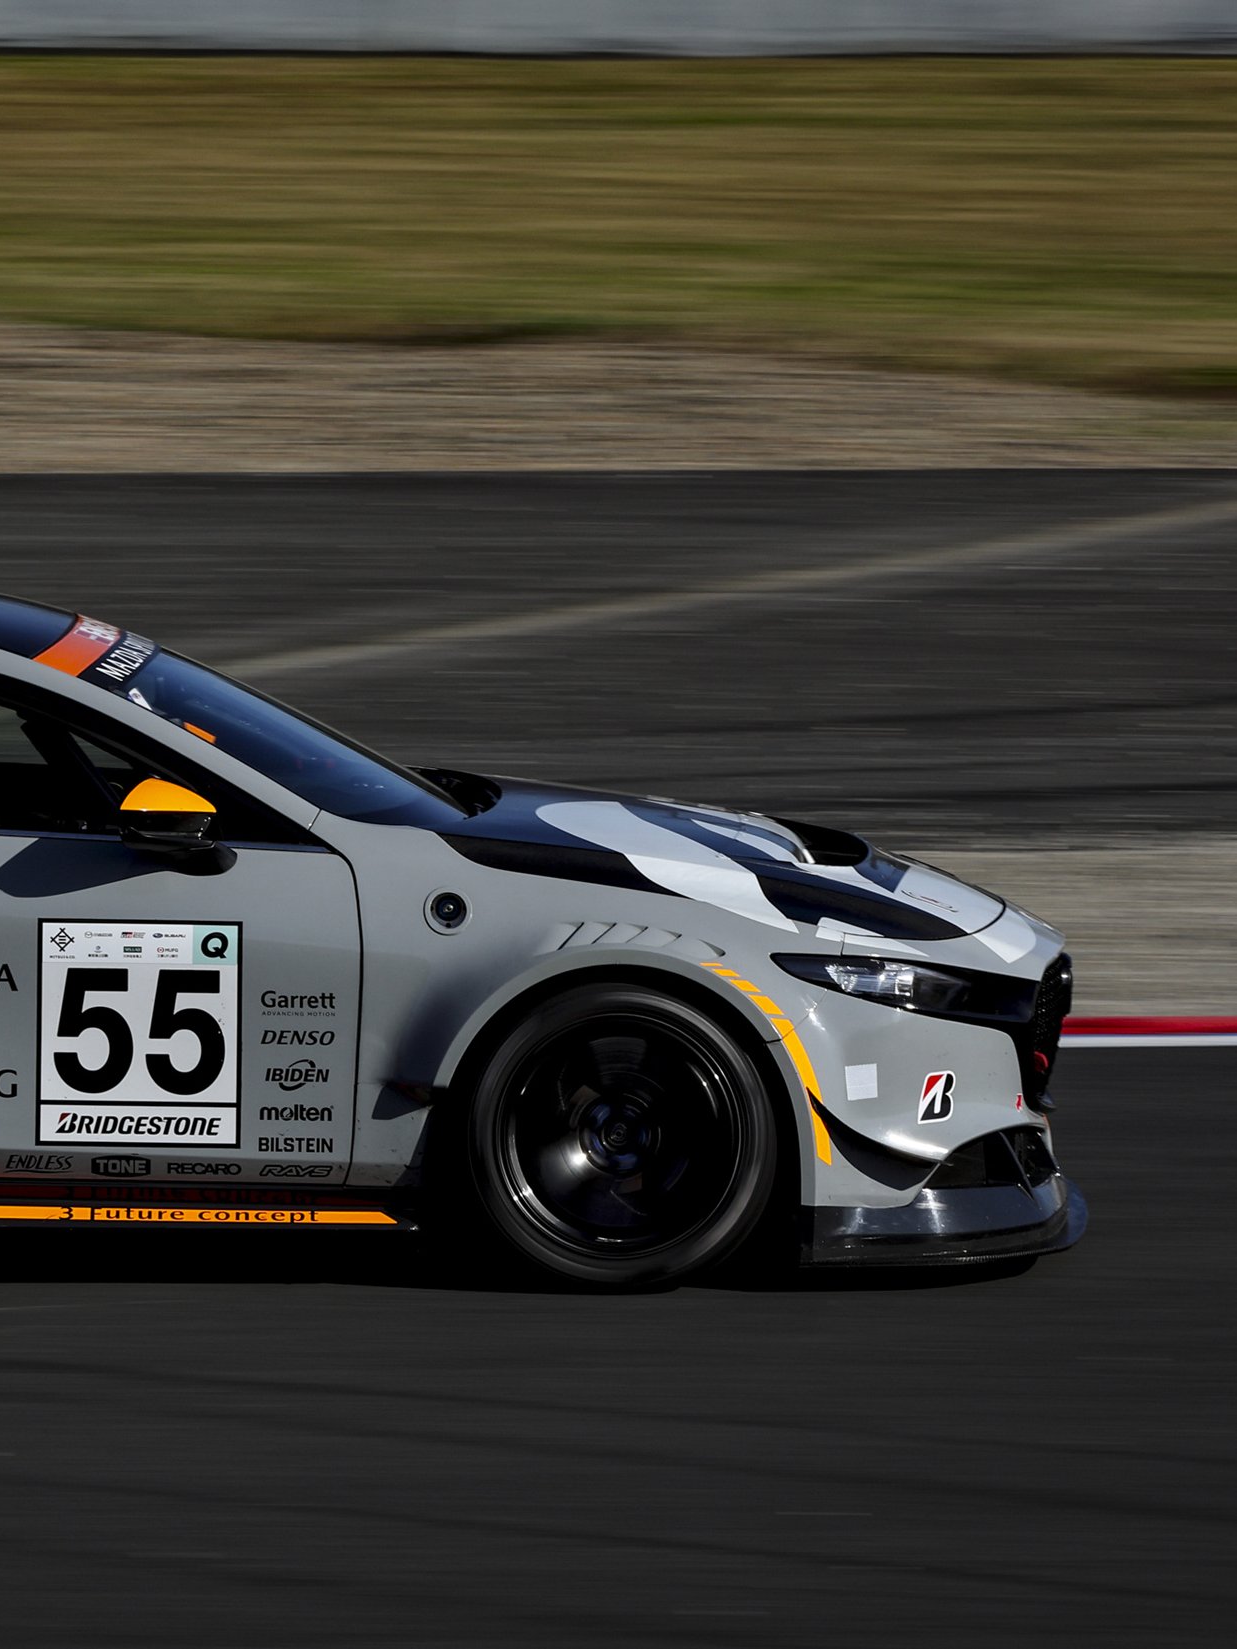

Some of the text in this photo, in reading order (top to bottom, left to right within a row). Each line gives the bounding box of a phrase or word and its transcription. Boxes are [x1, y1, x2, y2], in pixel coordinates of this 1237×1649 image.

[200, 932, 229, 959] Q
[260, 990, 336, 1009] Garrett
[53, 967, 226, 1096] 55
[260, 1030, 335, 1046] DENSO
[265, 1068, 330, 1083] IBIDEN
[259, 1104, 332, 1121] molten
[55, 1112, 222, 1136] BRIDGESTONE
[258, 1137, 333, 1153] BILSTEIN
[6, 1154, 74, 1171] ENDLESS
[96, 1159, 147, 1174] TONE
[167, 1162, 242, 1176] RECARO
[259, 1165, 333, 1178] RAYS
[58, 1206, 319, 1225] 3 Future concept
